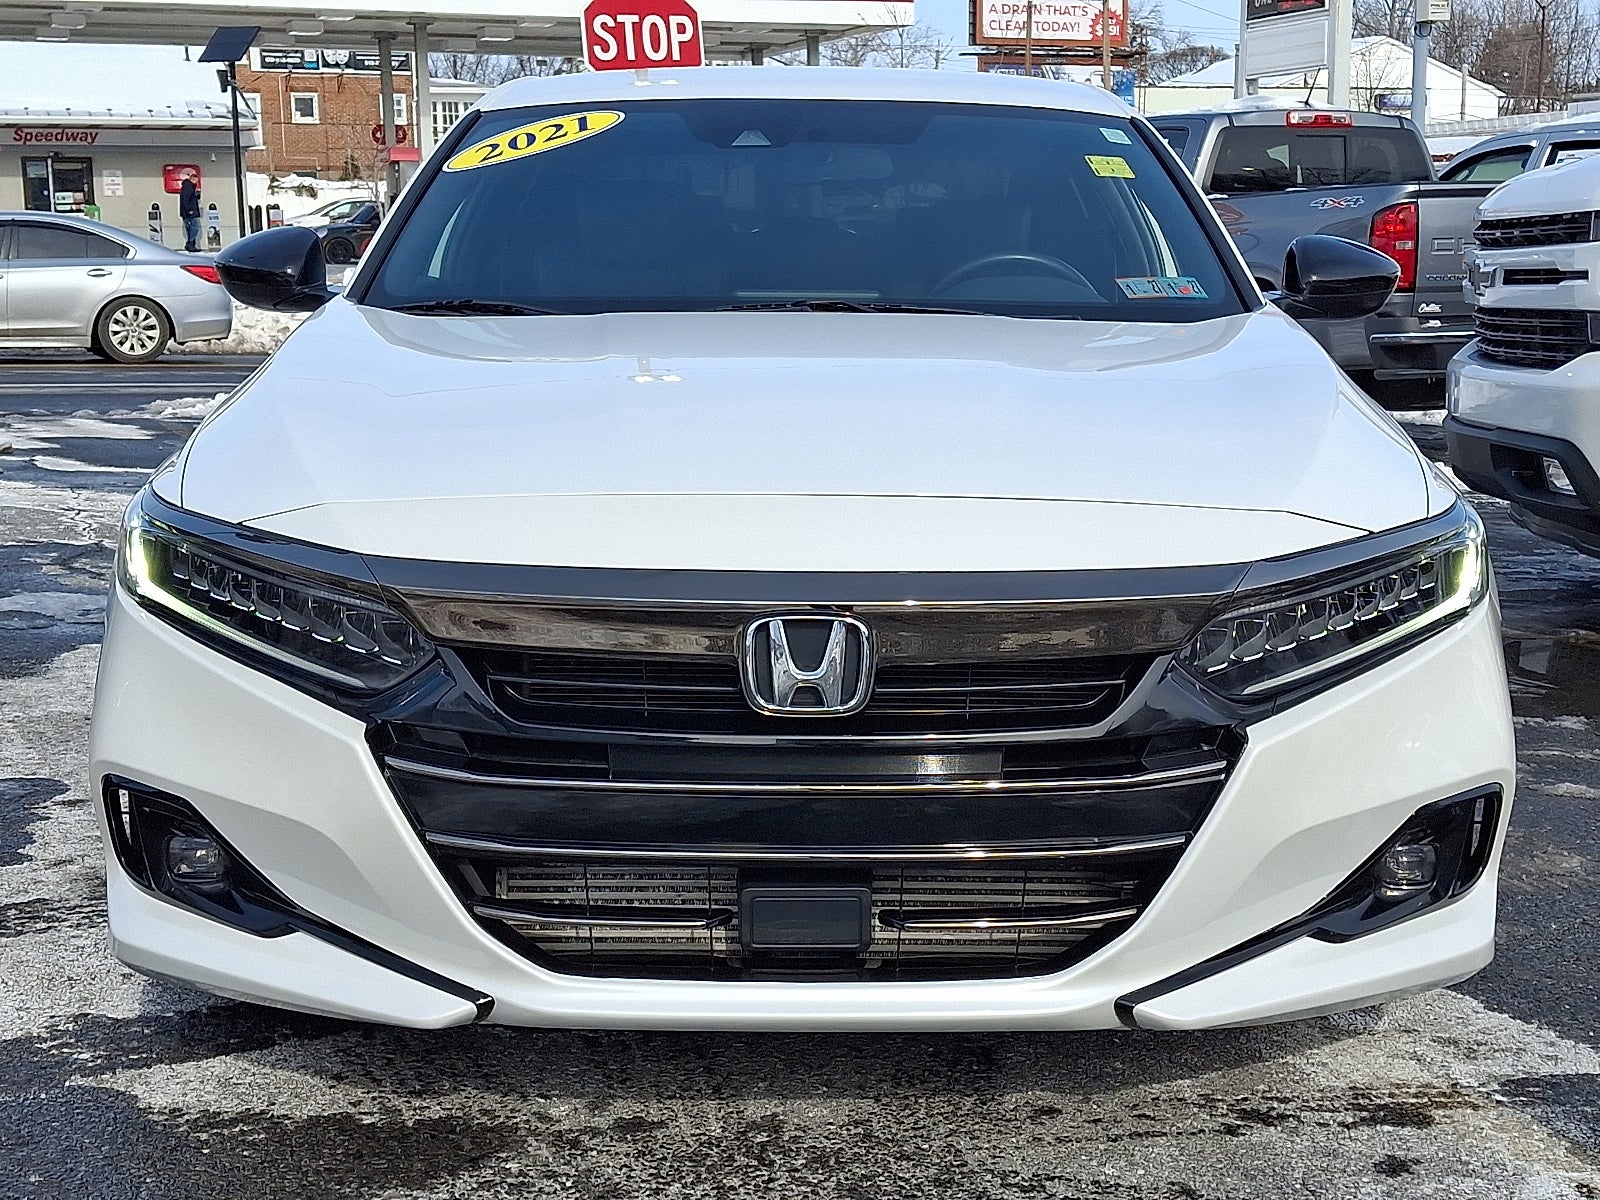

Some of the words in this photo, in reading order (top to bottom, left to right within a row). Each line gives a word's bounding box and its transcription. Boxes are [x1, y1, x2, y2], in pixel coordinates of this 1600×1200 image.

[988, 3, 998, 15] A
[1001, 4, 1042, 16] DRAN
[1046, 5, 1089, 17] THAT'S
[1034, 20, 1080, 33] TODAY!
[592, 14, 694, 61] STOP
[13, 127, 98, 145] Speedway
[475, 115, 595, 164] 2021
